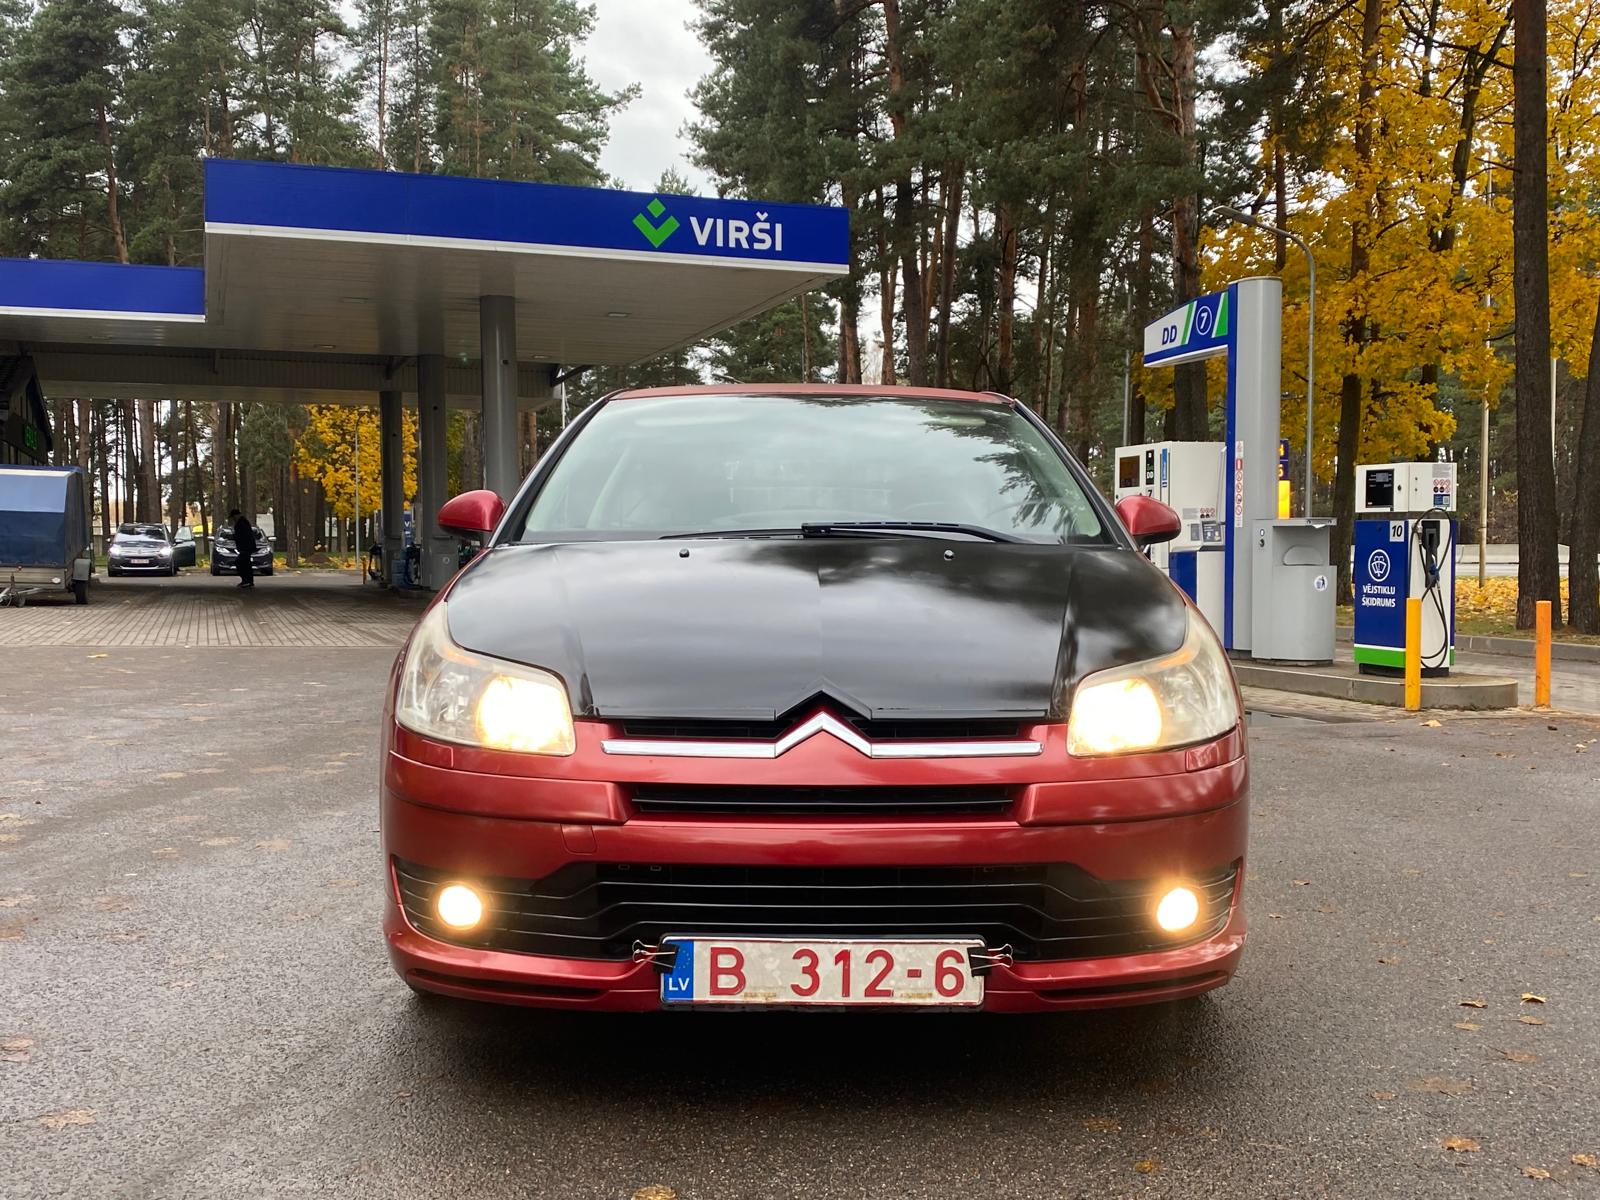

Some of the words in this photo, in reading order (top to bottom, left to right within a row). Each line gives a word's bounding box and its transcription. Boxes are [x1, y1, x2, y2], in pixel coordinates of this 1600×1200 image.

[689, 211, 783, 252] VIRŠI
[1162, 325, 1177, 345] DD
[1200, 312, 1208, 330] 7
[1391, 525, 1403, 538] 10
[1362, 583, 1396, 595] VĒJSTIKLU
[1361, 594, 1396, 608] ŠĶIDRUMS
[709, 946, 747, 997] B
[790, 947, 966, 998] 312-6
[668, 977, 690, 992] LV
